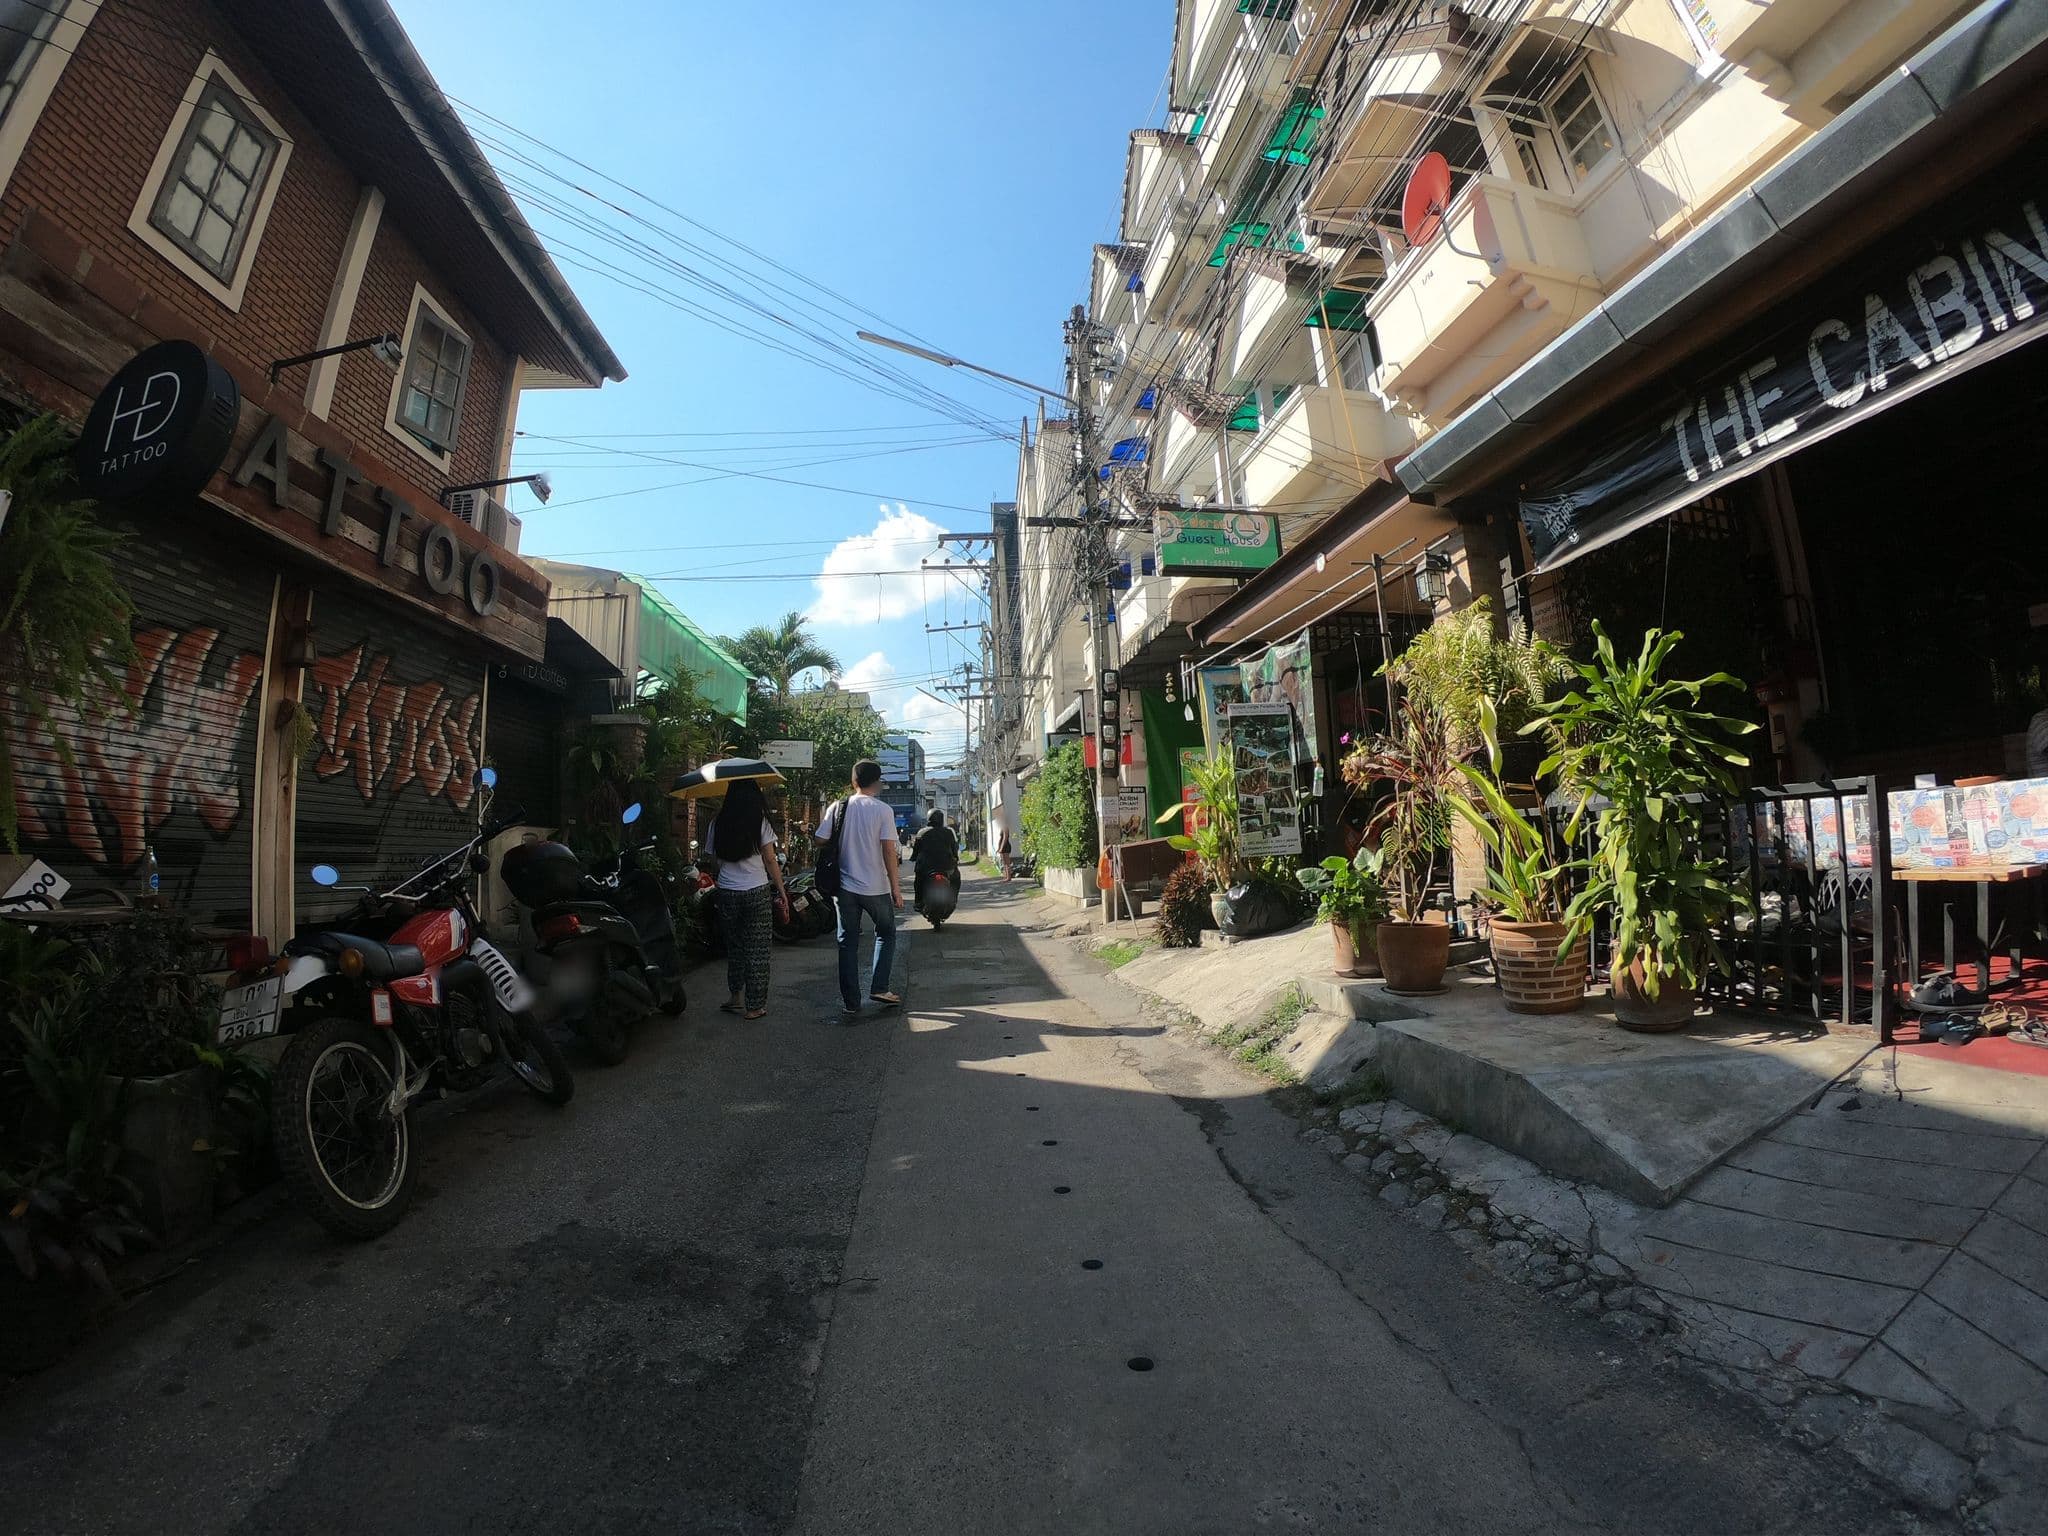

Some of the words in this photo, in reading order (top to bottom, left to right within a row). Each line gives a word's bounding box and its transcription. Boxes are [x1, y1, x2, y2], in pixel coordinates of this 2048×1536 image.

[1660, 355, 1798, 482] THE
[1806, 201, 2048, 409] CABIN
[104, 371, 181, 453] HD
[100, 442, 167, 475] TATTOO
[1176, 532, 1216, 545] Guest
[1223, 535, 1261, 546] House
